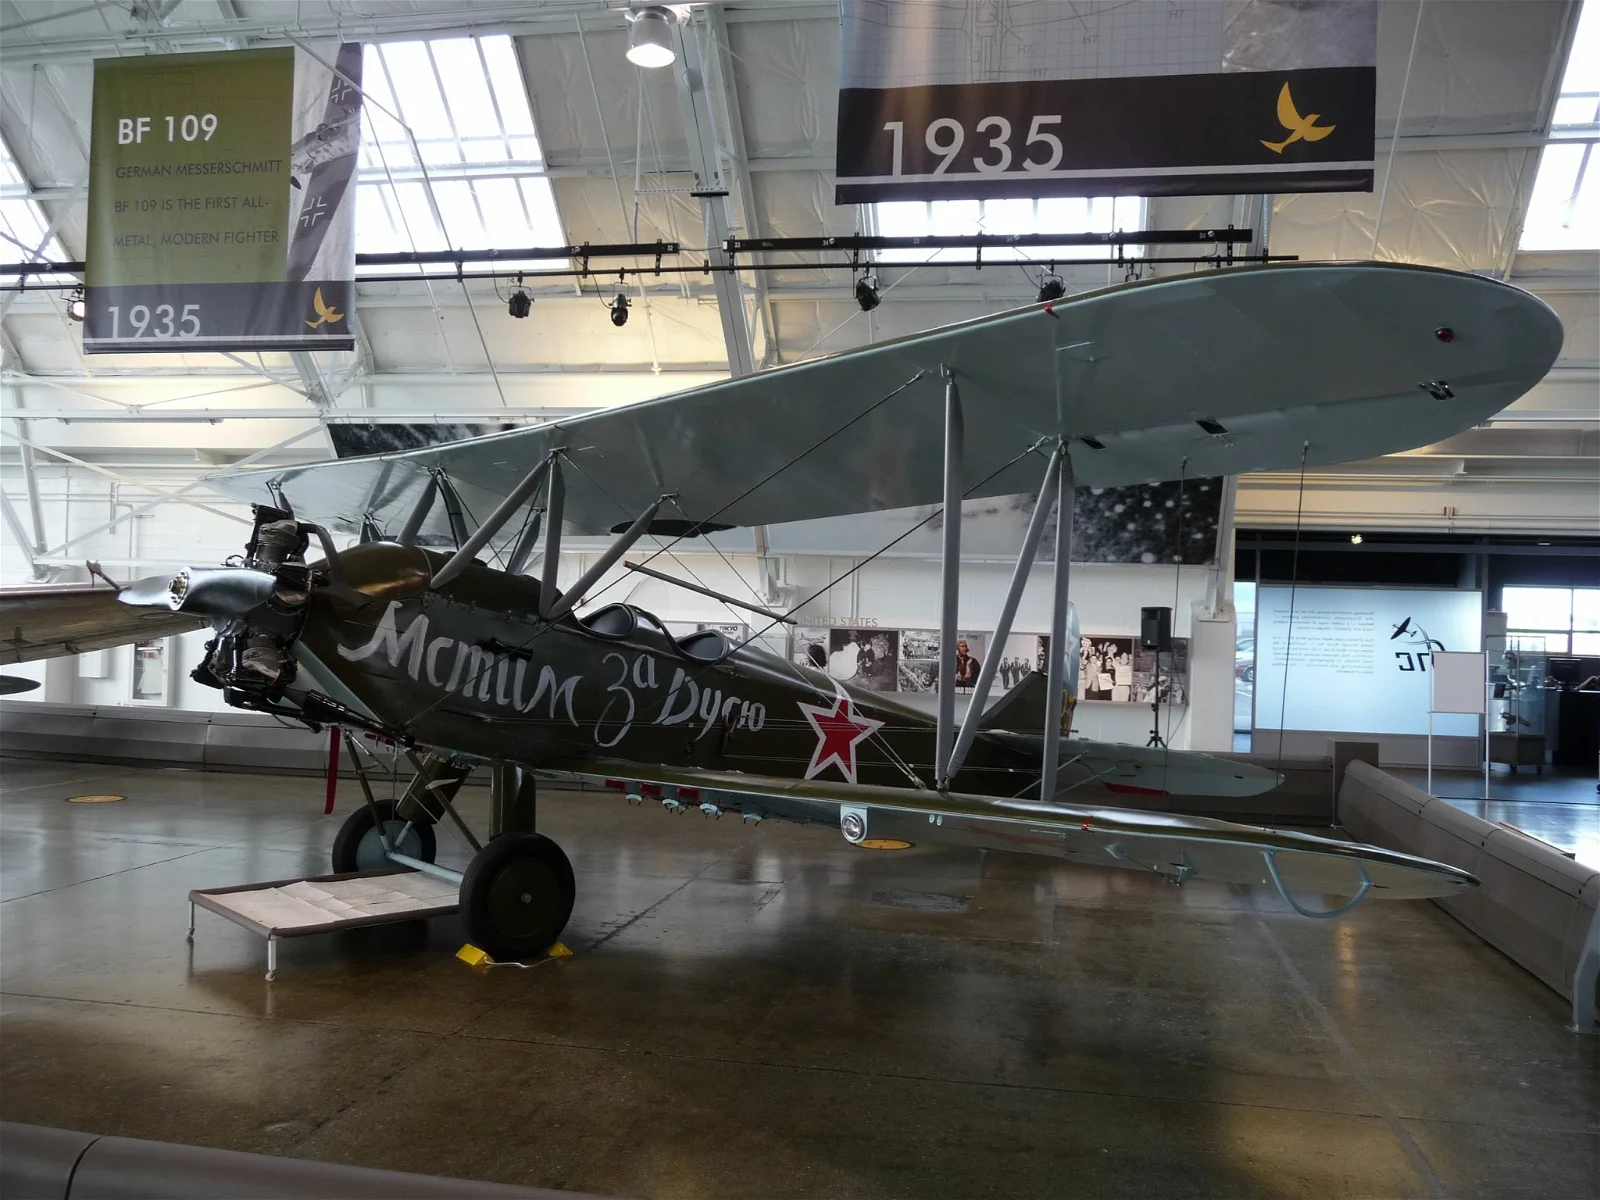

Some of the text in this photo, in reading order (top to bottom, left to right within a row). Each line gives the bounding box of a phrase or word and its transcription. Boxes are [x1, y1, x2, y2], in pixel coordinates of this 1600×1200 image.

[118, 113, 218, 144] BF 109
[883, 115, 1063, 176] 1935
[115, 159, 283, 179] GERMAN MESSERSCHMITT
[115, 195, 269, 213] BF 109 IS THE FIRST ALL-
[113, 230, 279, 248] METAL, MODERN FIGHTER
[107, 304, 201, 339] 1935
[796, 616, 878, 627] UNITED STATES
